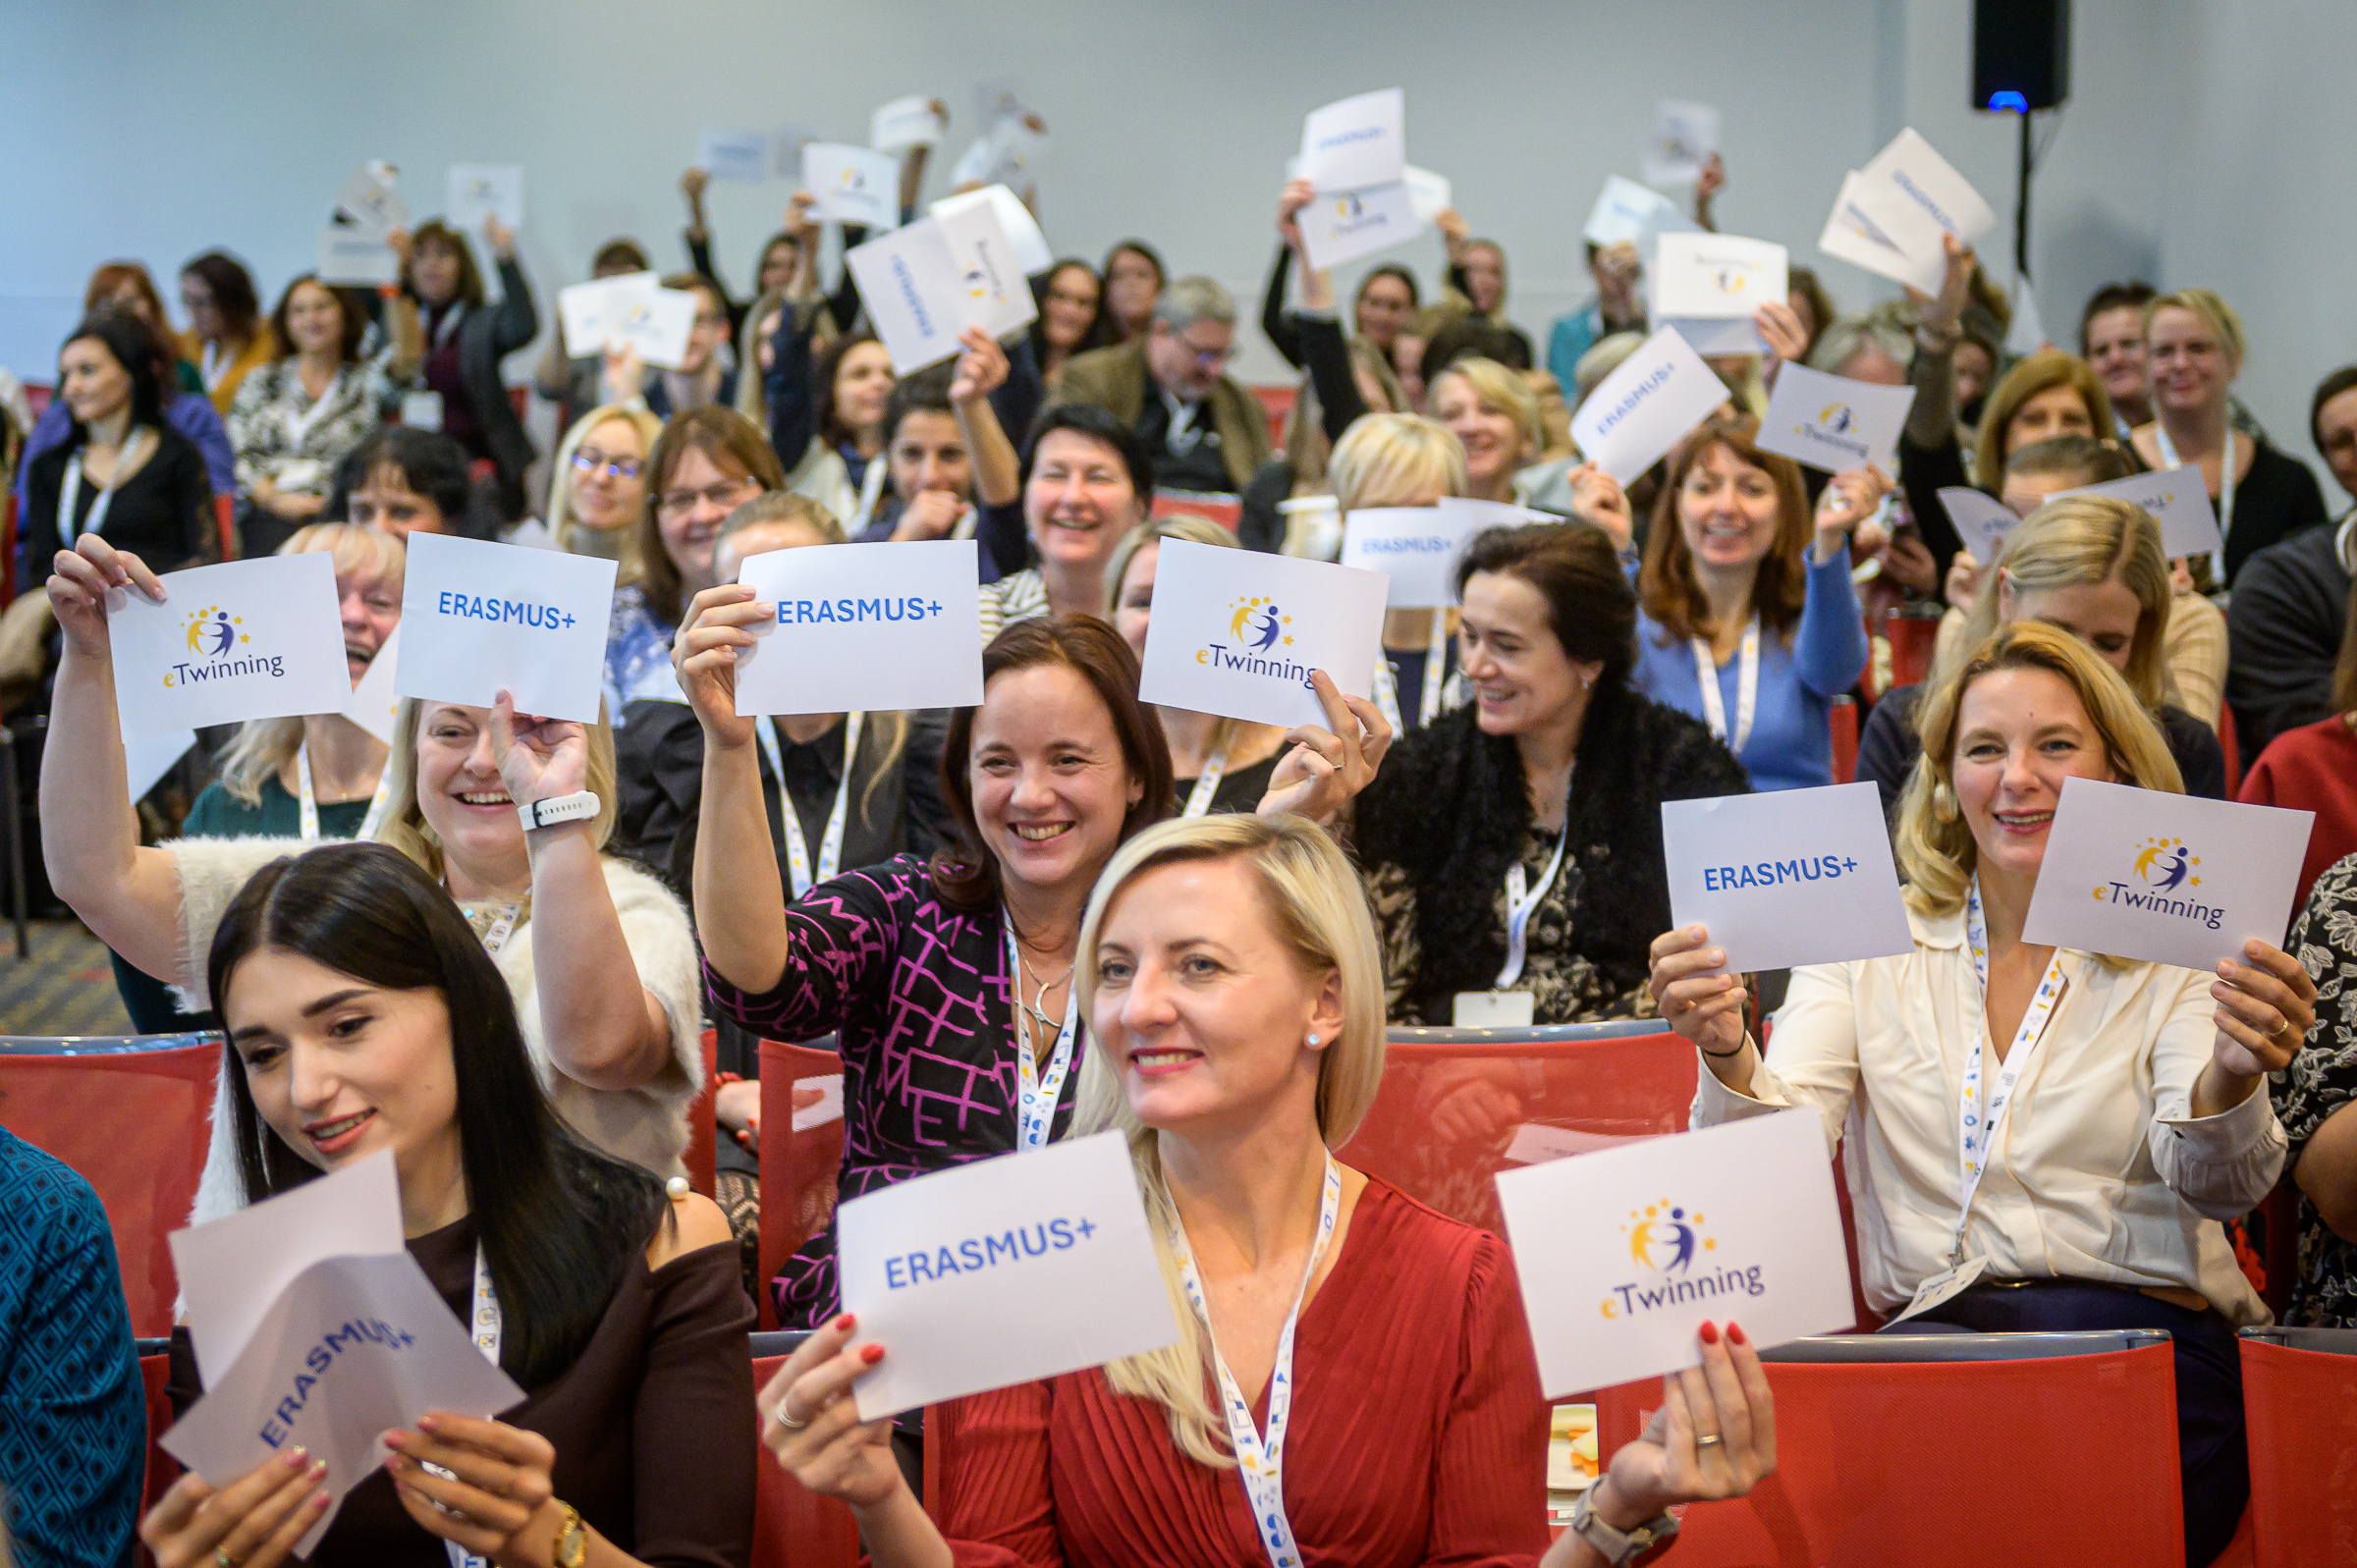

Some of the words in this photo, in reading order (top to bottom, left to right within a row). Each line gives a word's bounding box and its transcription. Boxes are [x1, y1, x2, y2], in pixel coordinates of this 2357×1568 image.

[1596, 360, 1675, 436] ERASMUS+
[438, 590, 576, 630] ERASMUS+
[777, 596, 944, 624] ERASMUS+
[162, 653, 286, 688] eTwinning
[1703, 854, 1858, 892] ERASMUS+
[2092, 881, 2226, 930] eTwinning
[884, 1217, 1097, 1291] ERASMUS+
[1599, 1264, 1766, 1321] eTwinning
